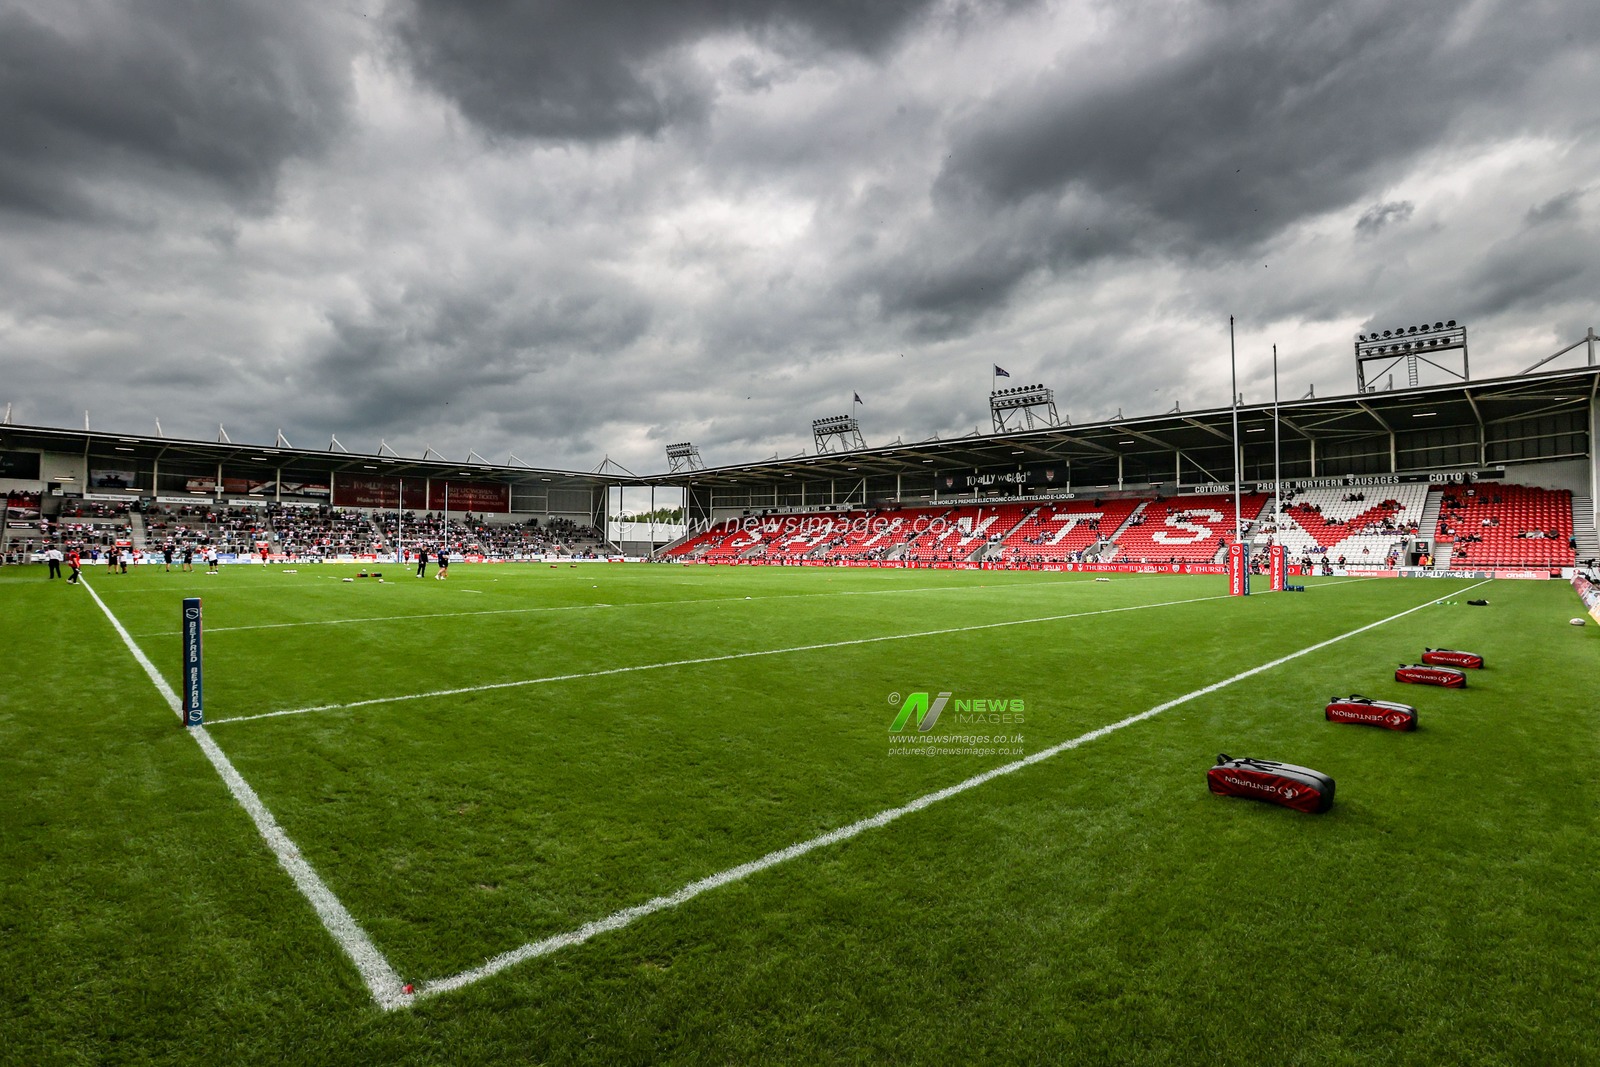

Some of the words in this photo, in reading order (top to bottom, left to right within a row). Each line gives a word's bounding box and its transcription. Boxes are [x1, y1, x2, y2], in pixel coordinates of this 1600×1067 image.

[1195, 485, 1230, 493] COTTOMS
[1295, 479, 1343, 488] NORTHERN
[1348, 476, 1399, 486] SAUSAGES
[1429, 472, 1478, 482] COTTOS
[189, 621, 198, 662] BETFRED
[190, 667, 199, 708] BETFRED
[1332, 709, 1383, 722] CENTURION
[1224, 775, 1276, 793] CENTURION
